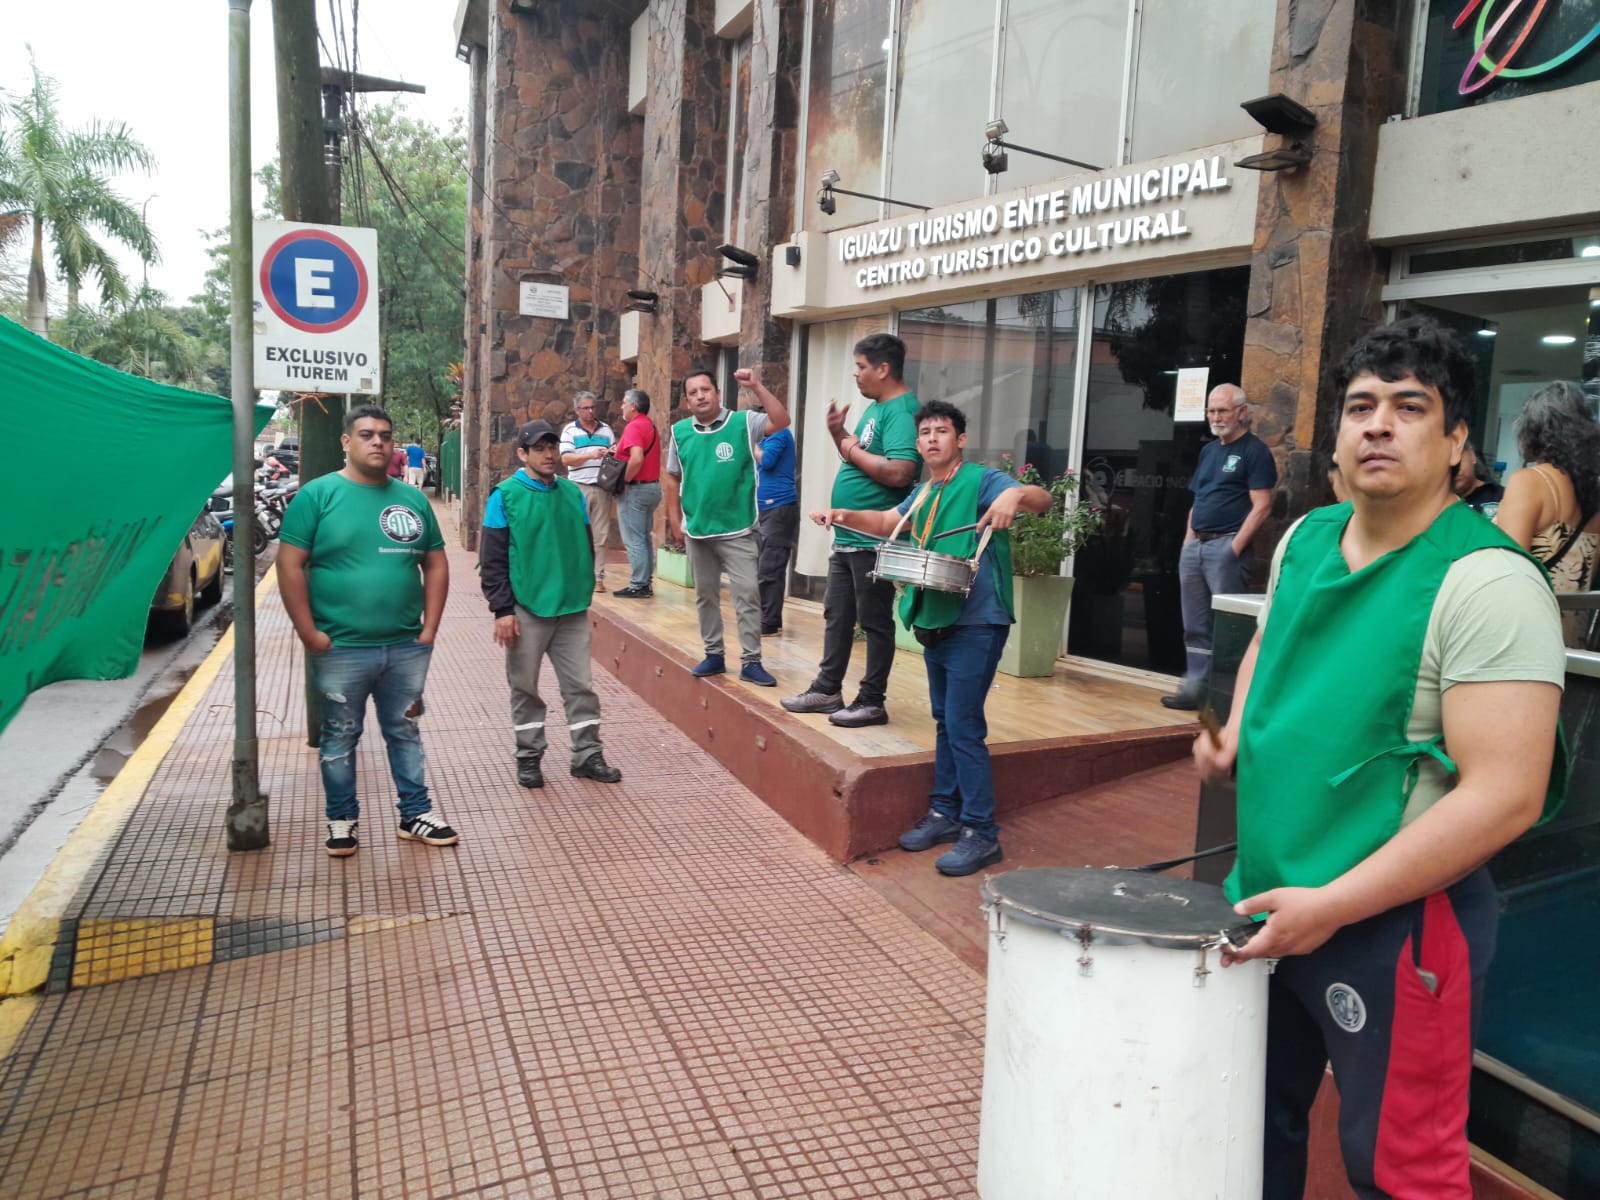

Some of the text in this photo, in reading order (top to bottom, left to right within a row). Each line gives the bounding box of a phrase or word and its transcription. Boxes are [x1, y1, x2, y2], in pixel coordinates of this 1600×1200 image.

[839, 156, 1228, 262] IGUAZU TURISMO ENTE MUNICIPAL
[856, 209, 1188, 289] CENTRO TURISTICO CULTURAL
[294, 257, 335, 308] E
[266, 346, 367, 367] EXCLUSIVO
[286, 365, 348, 381] ITUREM
